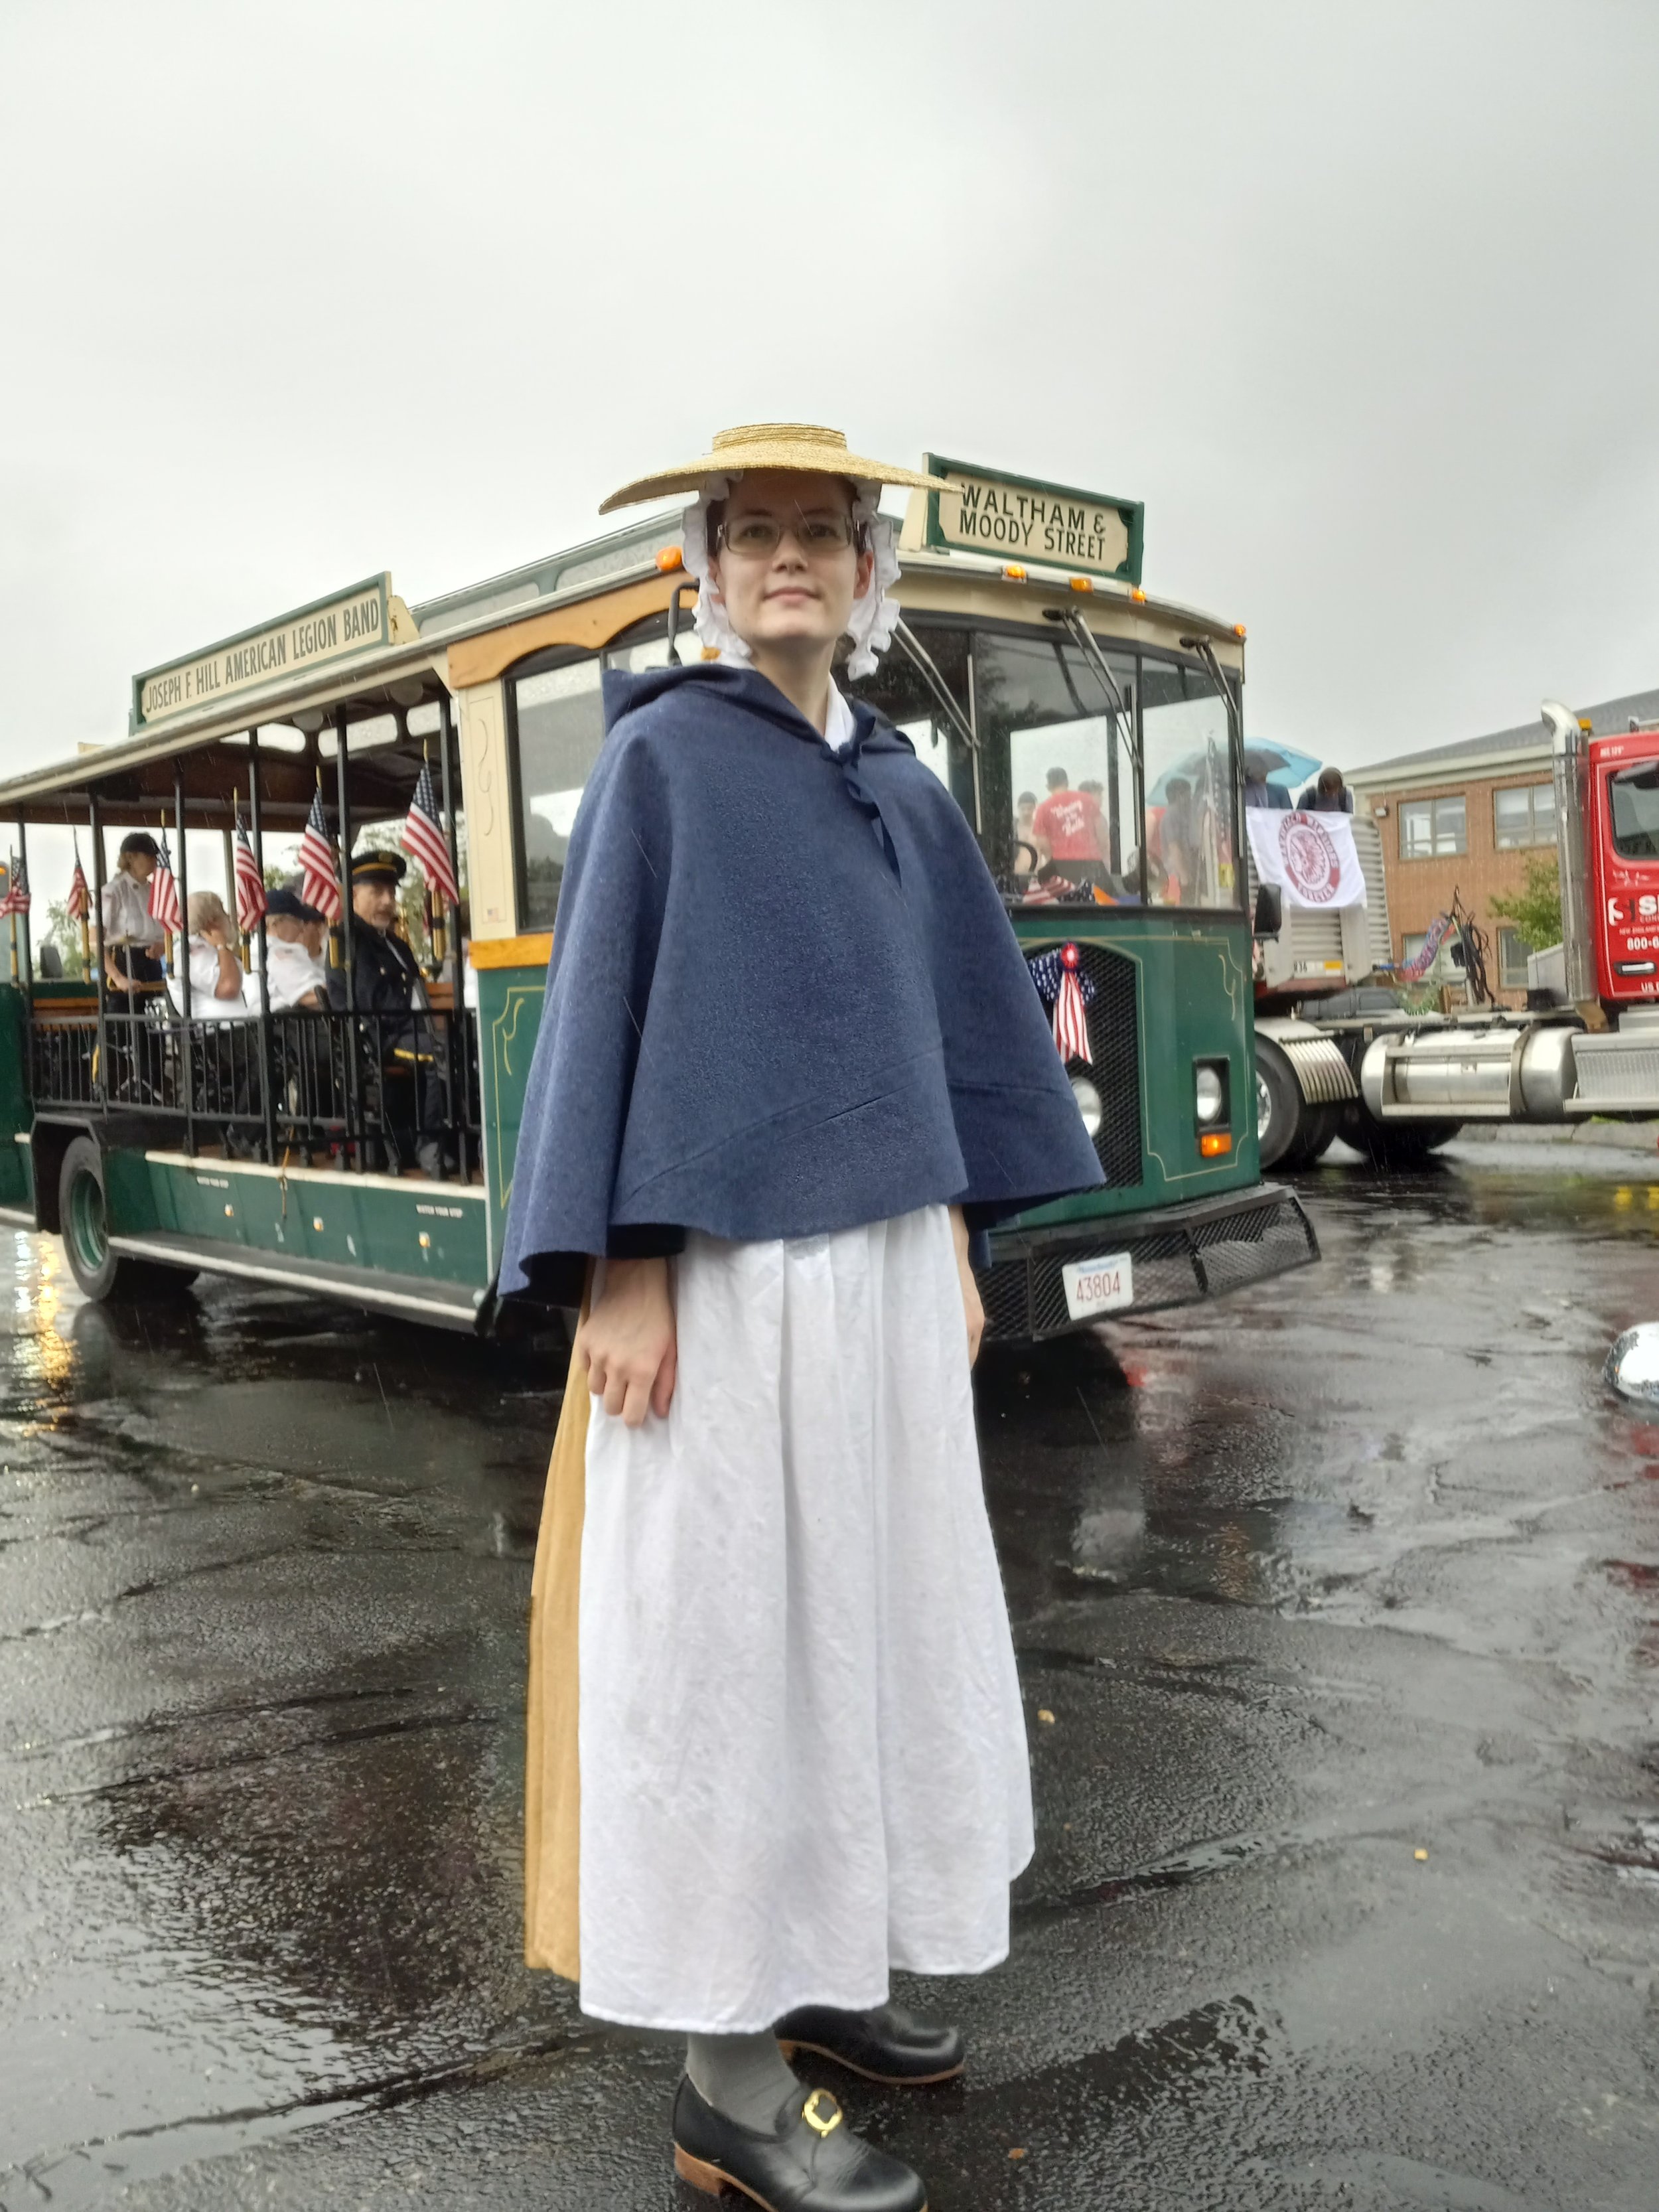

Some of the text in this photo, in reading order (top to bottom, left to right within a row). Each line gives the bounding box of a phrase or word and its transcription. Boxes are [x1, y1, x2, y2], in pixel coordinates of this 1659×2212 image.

[959, 507, 1106, 561] MOODY STREET
[960, 482, 1106, 535] WALTHAM &
[145, 598, 379, 713] JOSEPH F. HILL AMERICAN LEGION BAND
[1638, 894, 1659, 917] S
[1076, 1270, 1121, 1303] 43804
